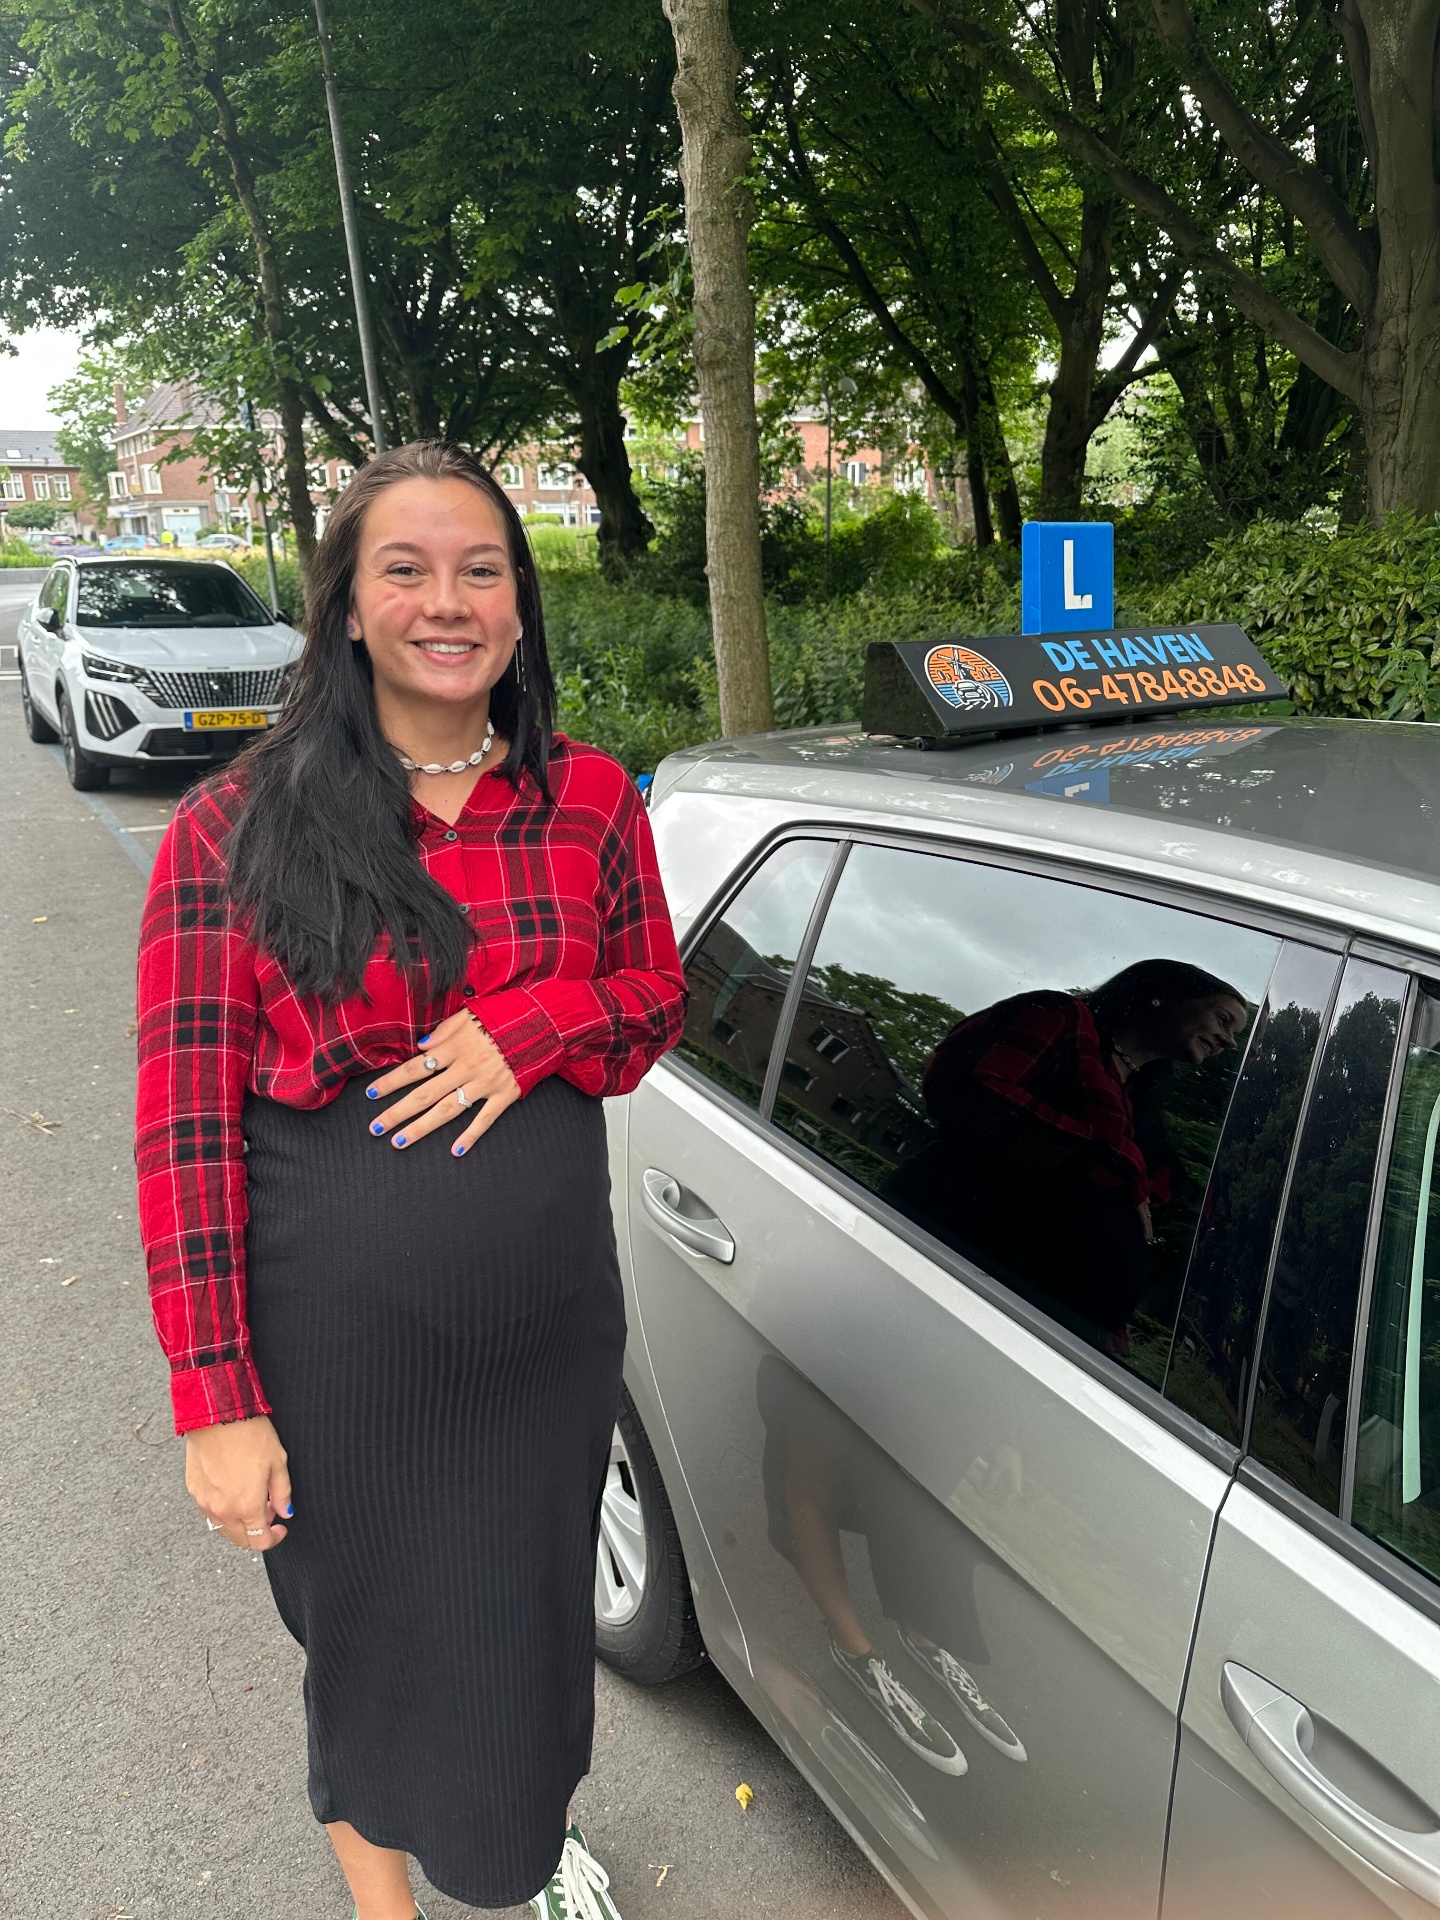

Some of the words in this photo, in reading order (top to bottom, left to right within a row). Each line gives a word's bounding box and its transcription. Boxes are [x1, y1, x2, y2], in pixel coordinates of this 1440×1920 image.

[1064, 540, 1093, 610] L
[1041, 639, 1099, 673] DE
[1091, 633, 1215, 669] HAVEN
[1032, 663, 1266, 712] 06-47848848
